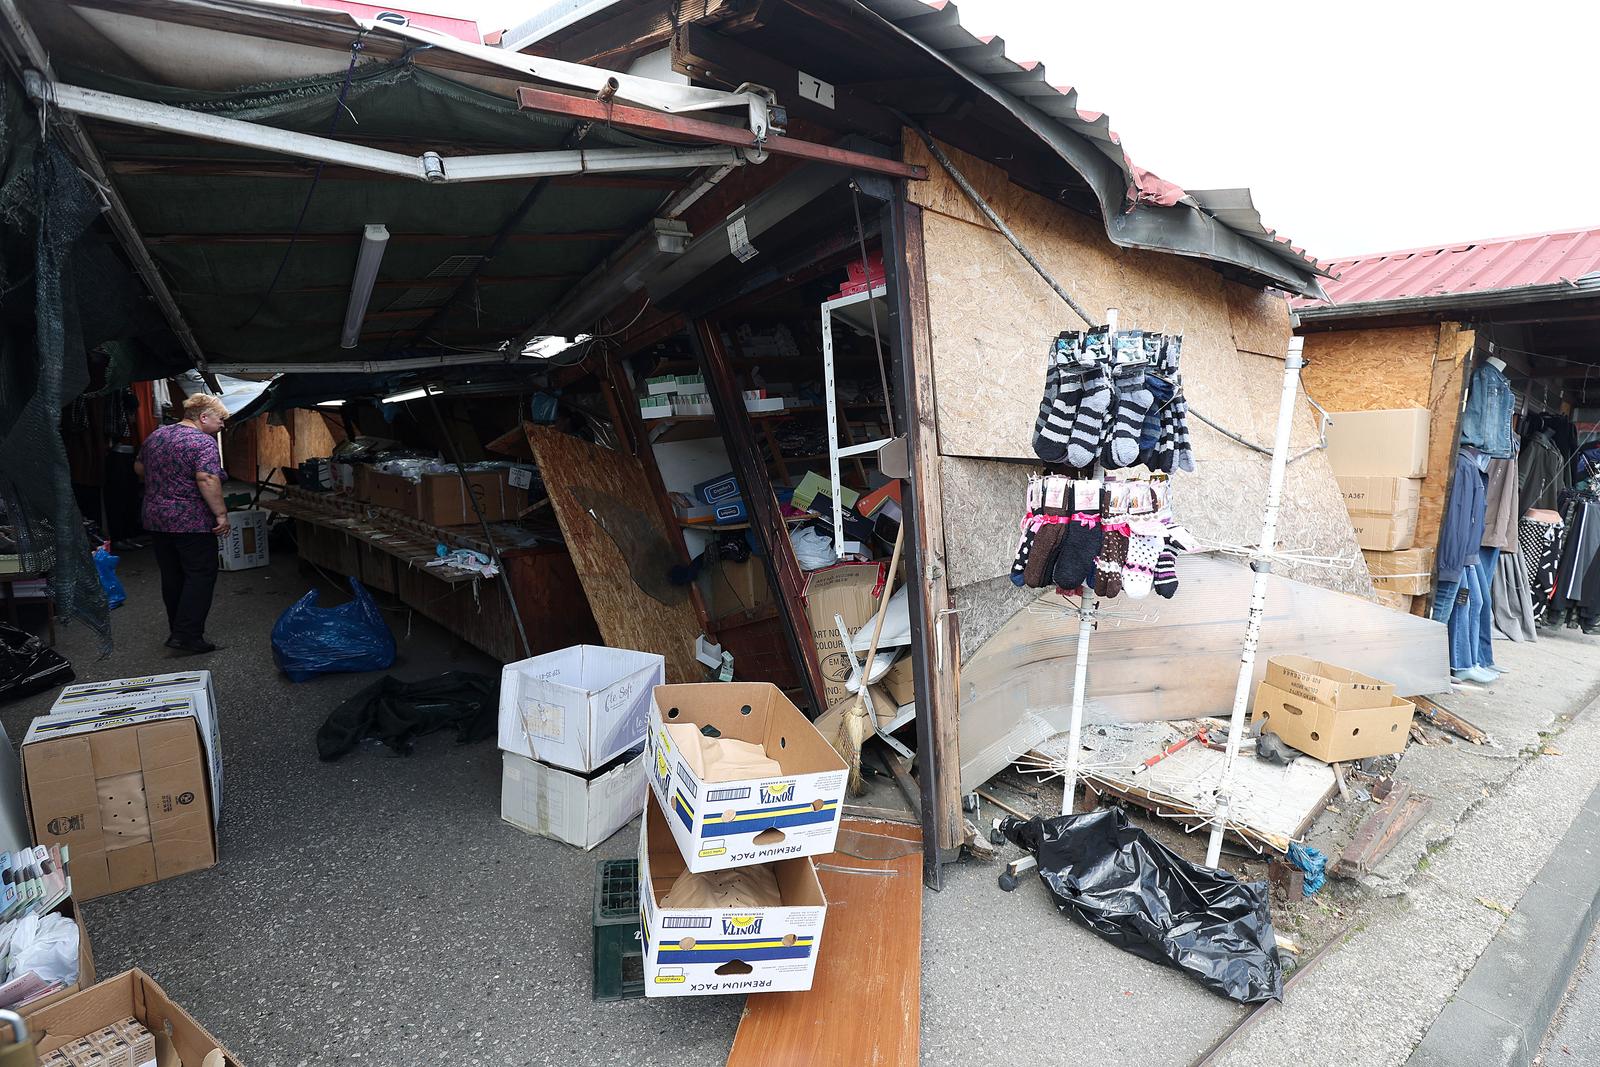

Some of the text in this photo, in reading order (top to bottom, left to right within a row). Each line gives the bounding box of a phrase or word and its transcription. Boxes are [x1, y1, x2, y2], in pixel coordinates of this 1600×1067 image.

[813, 80, 821, 99] 7
[232, 526, 240, 559] BONITA
[256, 519, 265, 560] BANANAS
[814, 629, 827, 640] ART
[759, 785, 795, 804] BONITA
[730, 844, 802, 862] PREMIUM PACK
[721, 918, 763, 936] BONITA
[690, 979, 773, 991] PREMIUM PACK
